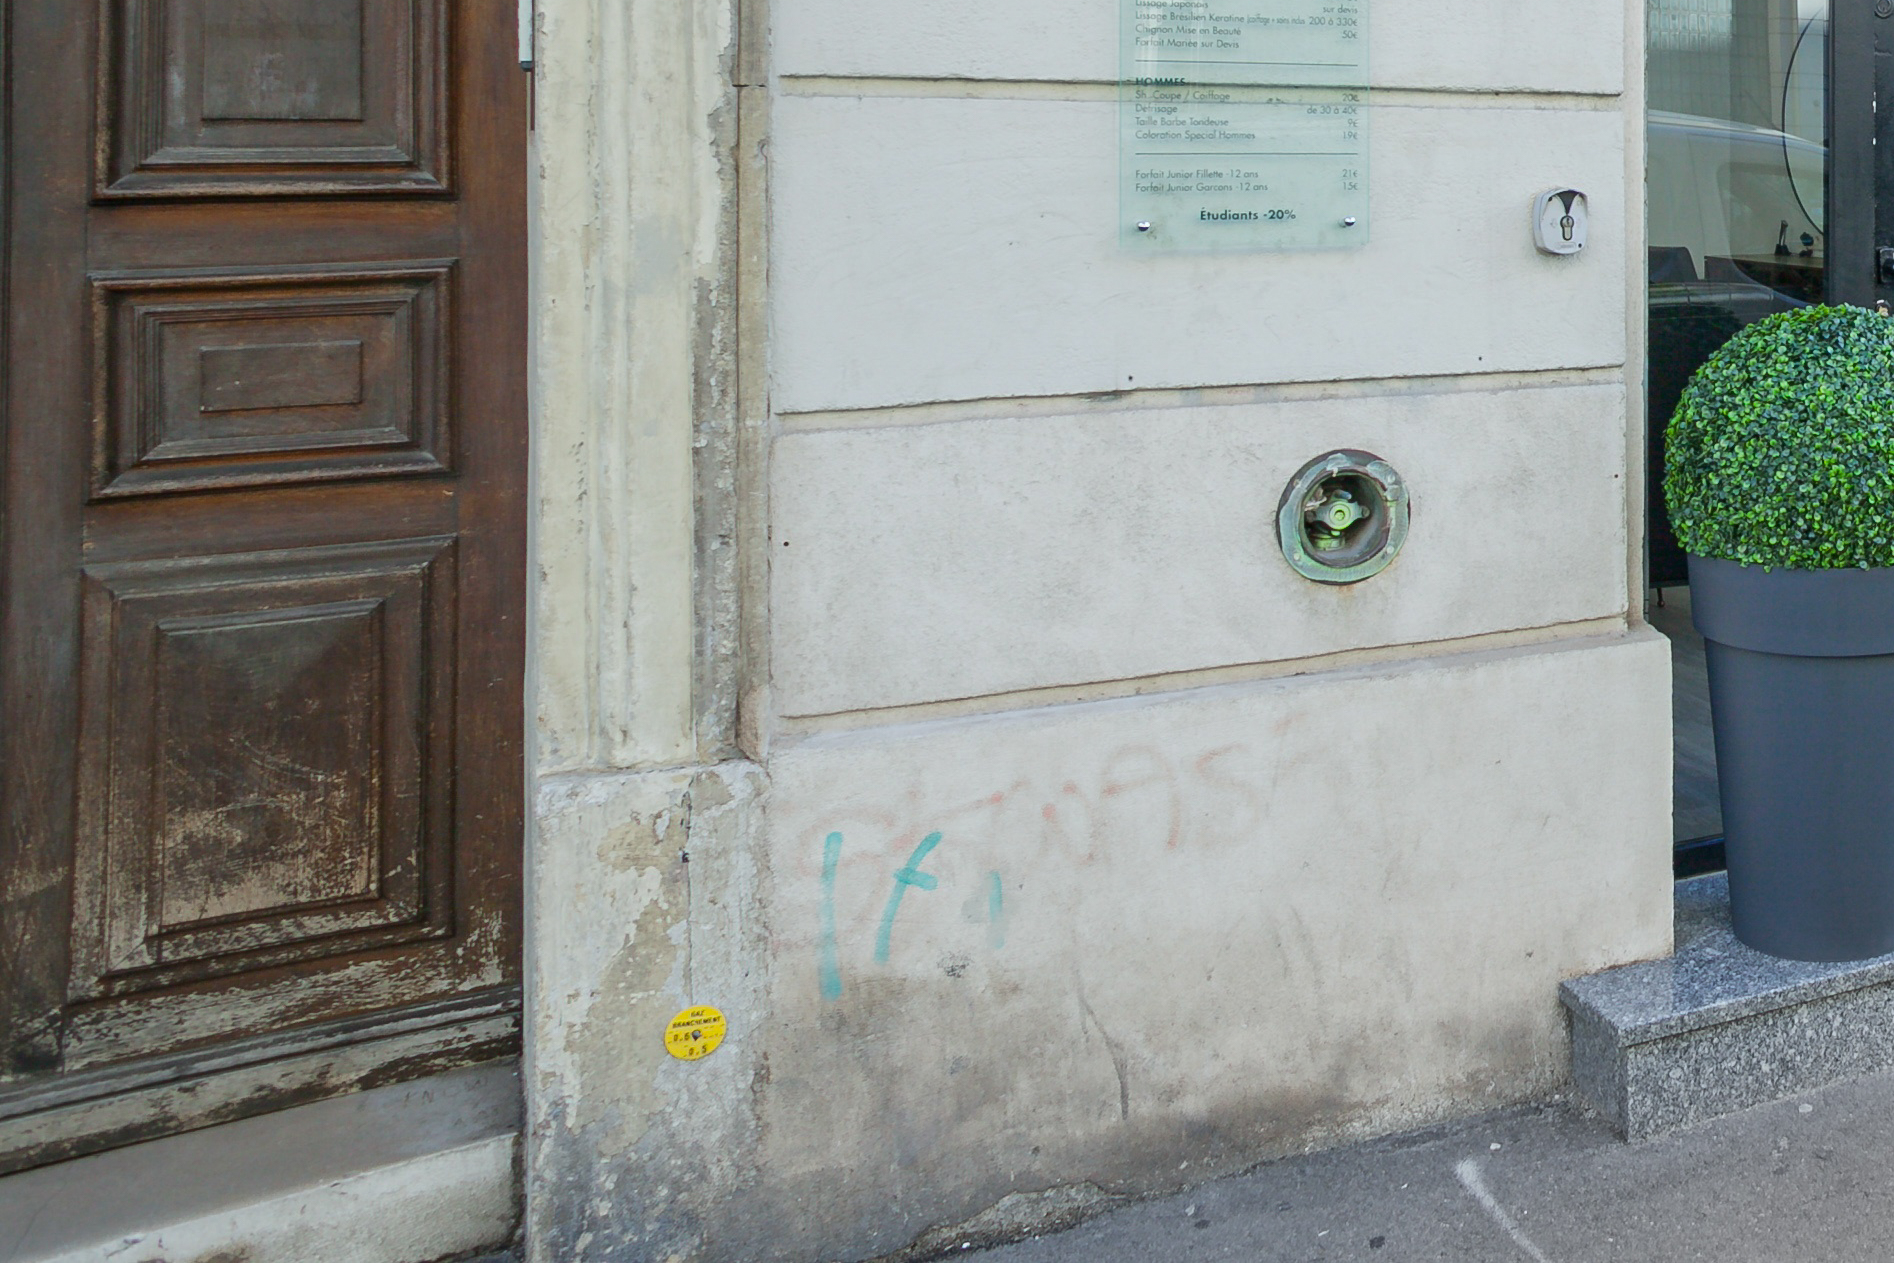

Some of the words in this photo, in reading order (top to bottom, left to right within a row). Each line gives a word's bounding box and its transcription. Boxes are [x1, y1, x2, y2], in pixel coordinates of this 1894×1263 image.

[1323, 5, 1335, 13] sur
[1337, 3, 1359, 15] devis
[1135, 11, 1168, 23] Lissage
[1308, 15, 1326, 26] 200
[1336, 17, 1359, 27] 330€
[1135, 23, 1173, 36] Chignon
[1175, 24, 1197, 35] Mise
[1199, 27, 1210, 35] en
[1212, 25, 1242, 36] Beauté
[1342, 29, 1359, 39] 50€
[1135, 36, 1164, 47] Forfait
[1166, 37, 1198, 48] Mariée
[1201, 40, 1213, 48] sur
[1216, 39, 1240, 49] Devis
[1135, 77, 1186, 87] HOMMES
[1152, 89, 1182, 101] Coupe
[1192, 89, 1231, 103] Coiffage
[1342, 93, 1360, 103] 20€
[1306, 105, 1318, 115] de
[1320, 105, 1332, 115] 30
[1342, 105, 1359, 115] 40€
[1134, 116, 1158, 126] Taille
[1160, 116, 1187, 127] Barbe
[1189, 116, 1229, 127] Tondeuse
[1347, 118, 1359, 128] 9€
[1135, 129, 1182, 140] Coloration
[1218, 130, 1256, 140] Hommes
[1343, 131, 1359, 140] 19€
[1135, 168, 1165, 179] Forfait
[1167, 169, 1194, 179] Junior
[1196, 168, 1224, 179] Fillette
[1342, 168, 1358, 178] 21€
[1135, 181, 1165, 192] Forfait
[1167, 182, 1194, 192] Junior
[1342, 181, 1358, 191] 15€
[1200, 206, 1259, 221] Étudiants
[1263, 209, 1297, 220] -20%
